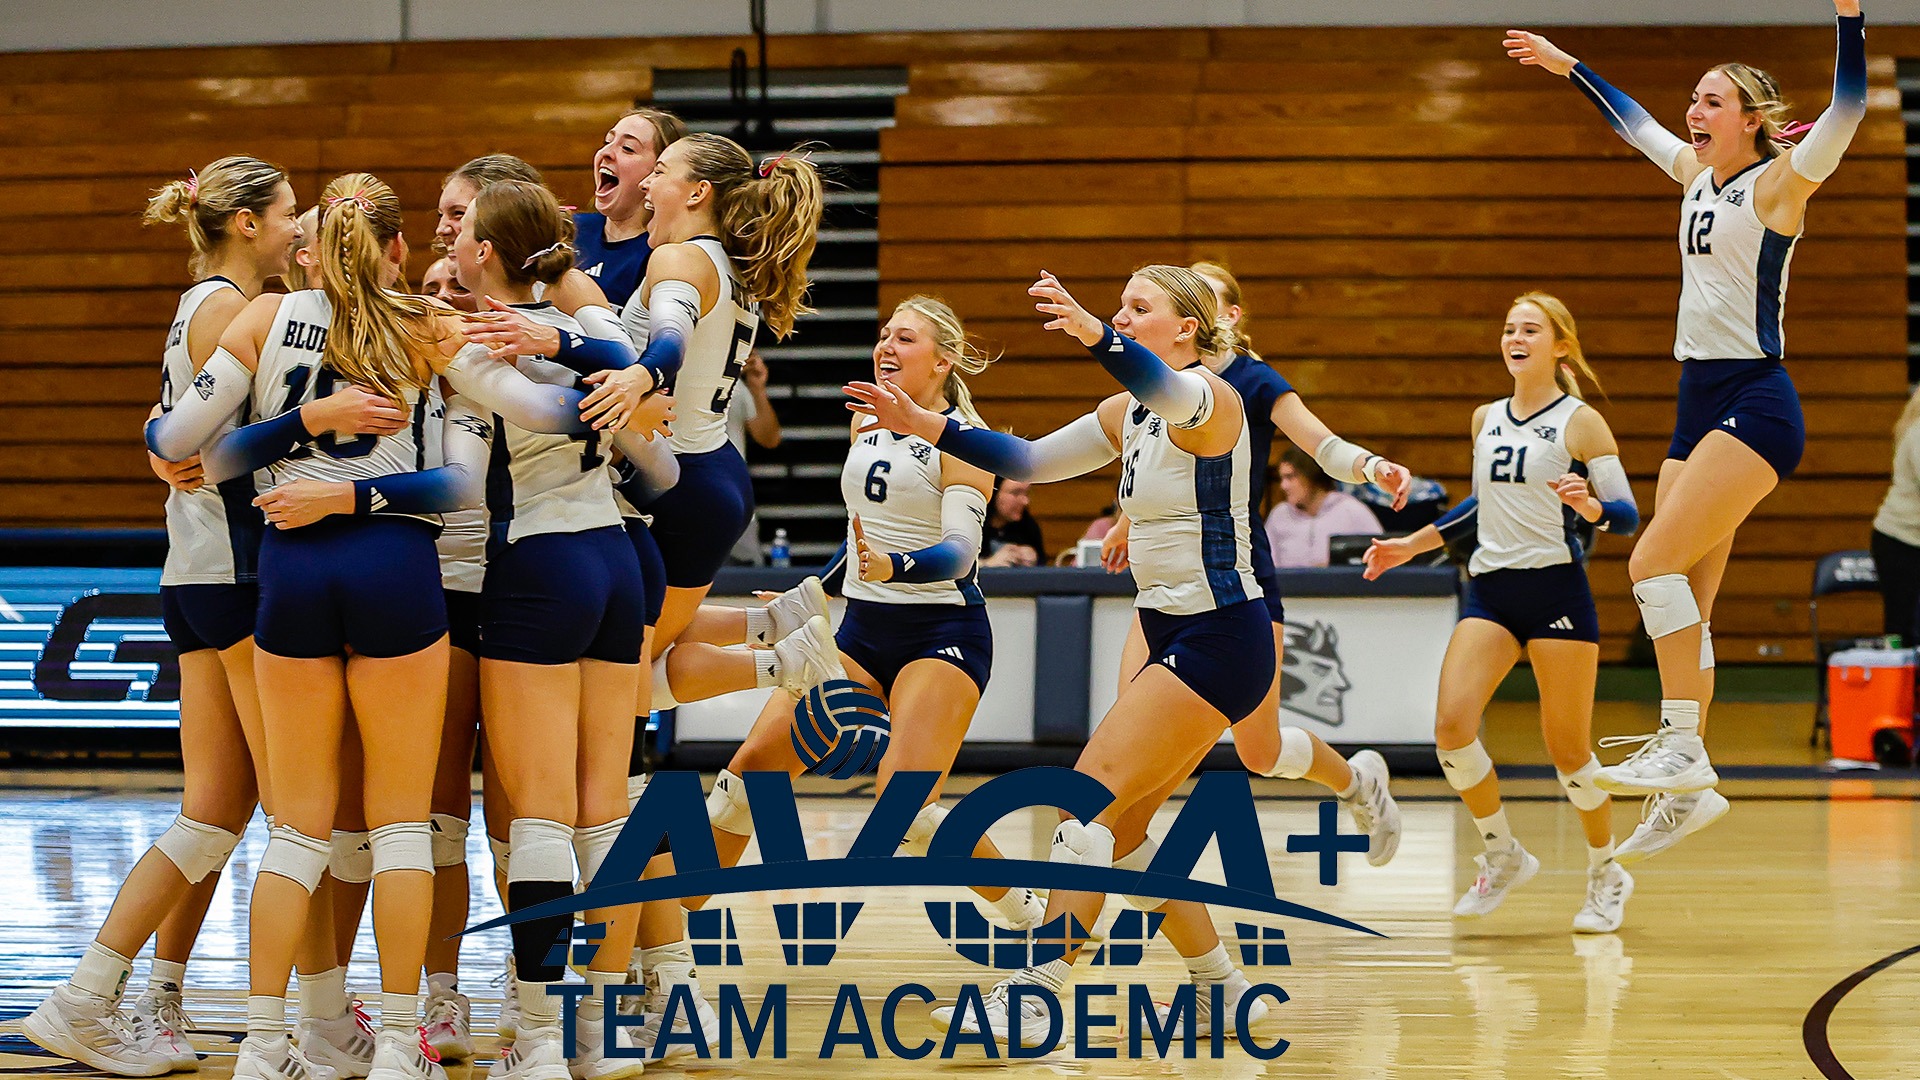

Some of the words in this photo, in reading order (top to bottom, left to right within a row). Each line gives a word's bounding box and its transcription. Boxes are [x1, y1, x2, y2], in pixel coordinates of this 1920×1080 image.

[1687, 210, 1714, 255] 12
[864, 460, 892, 503] 6
[1120, 448, 1141, 499] 16
[1490, 445, 1528, 484] 21
